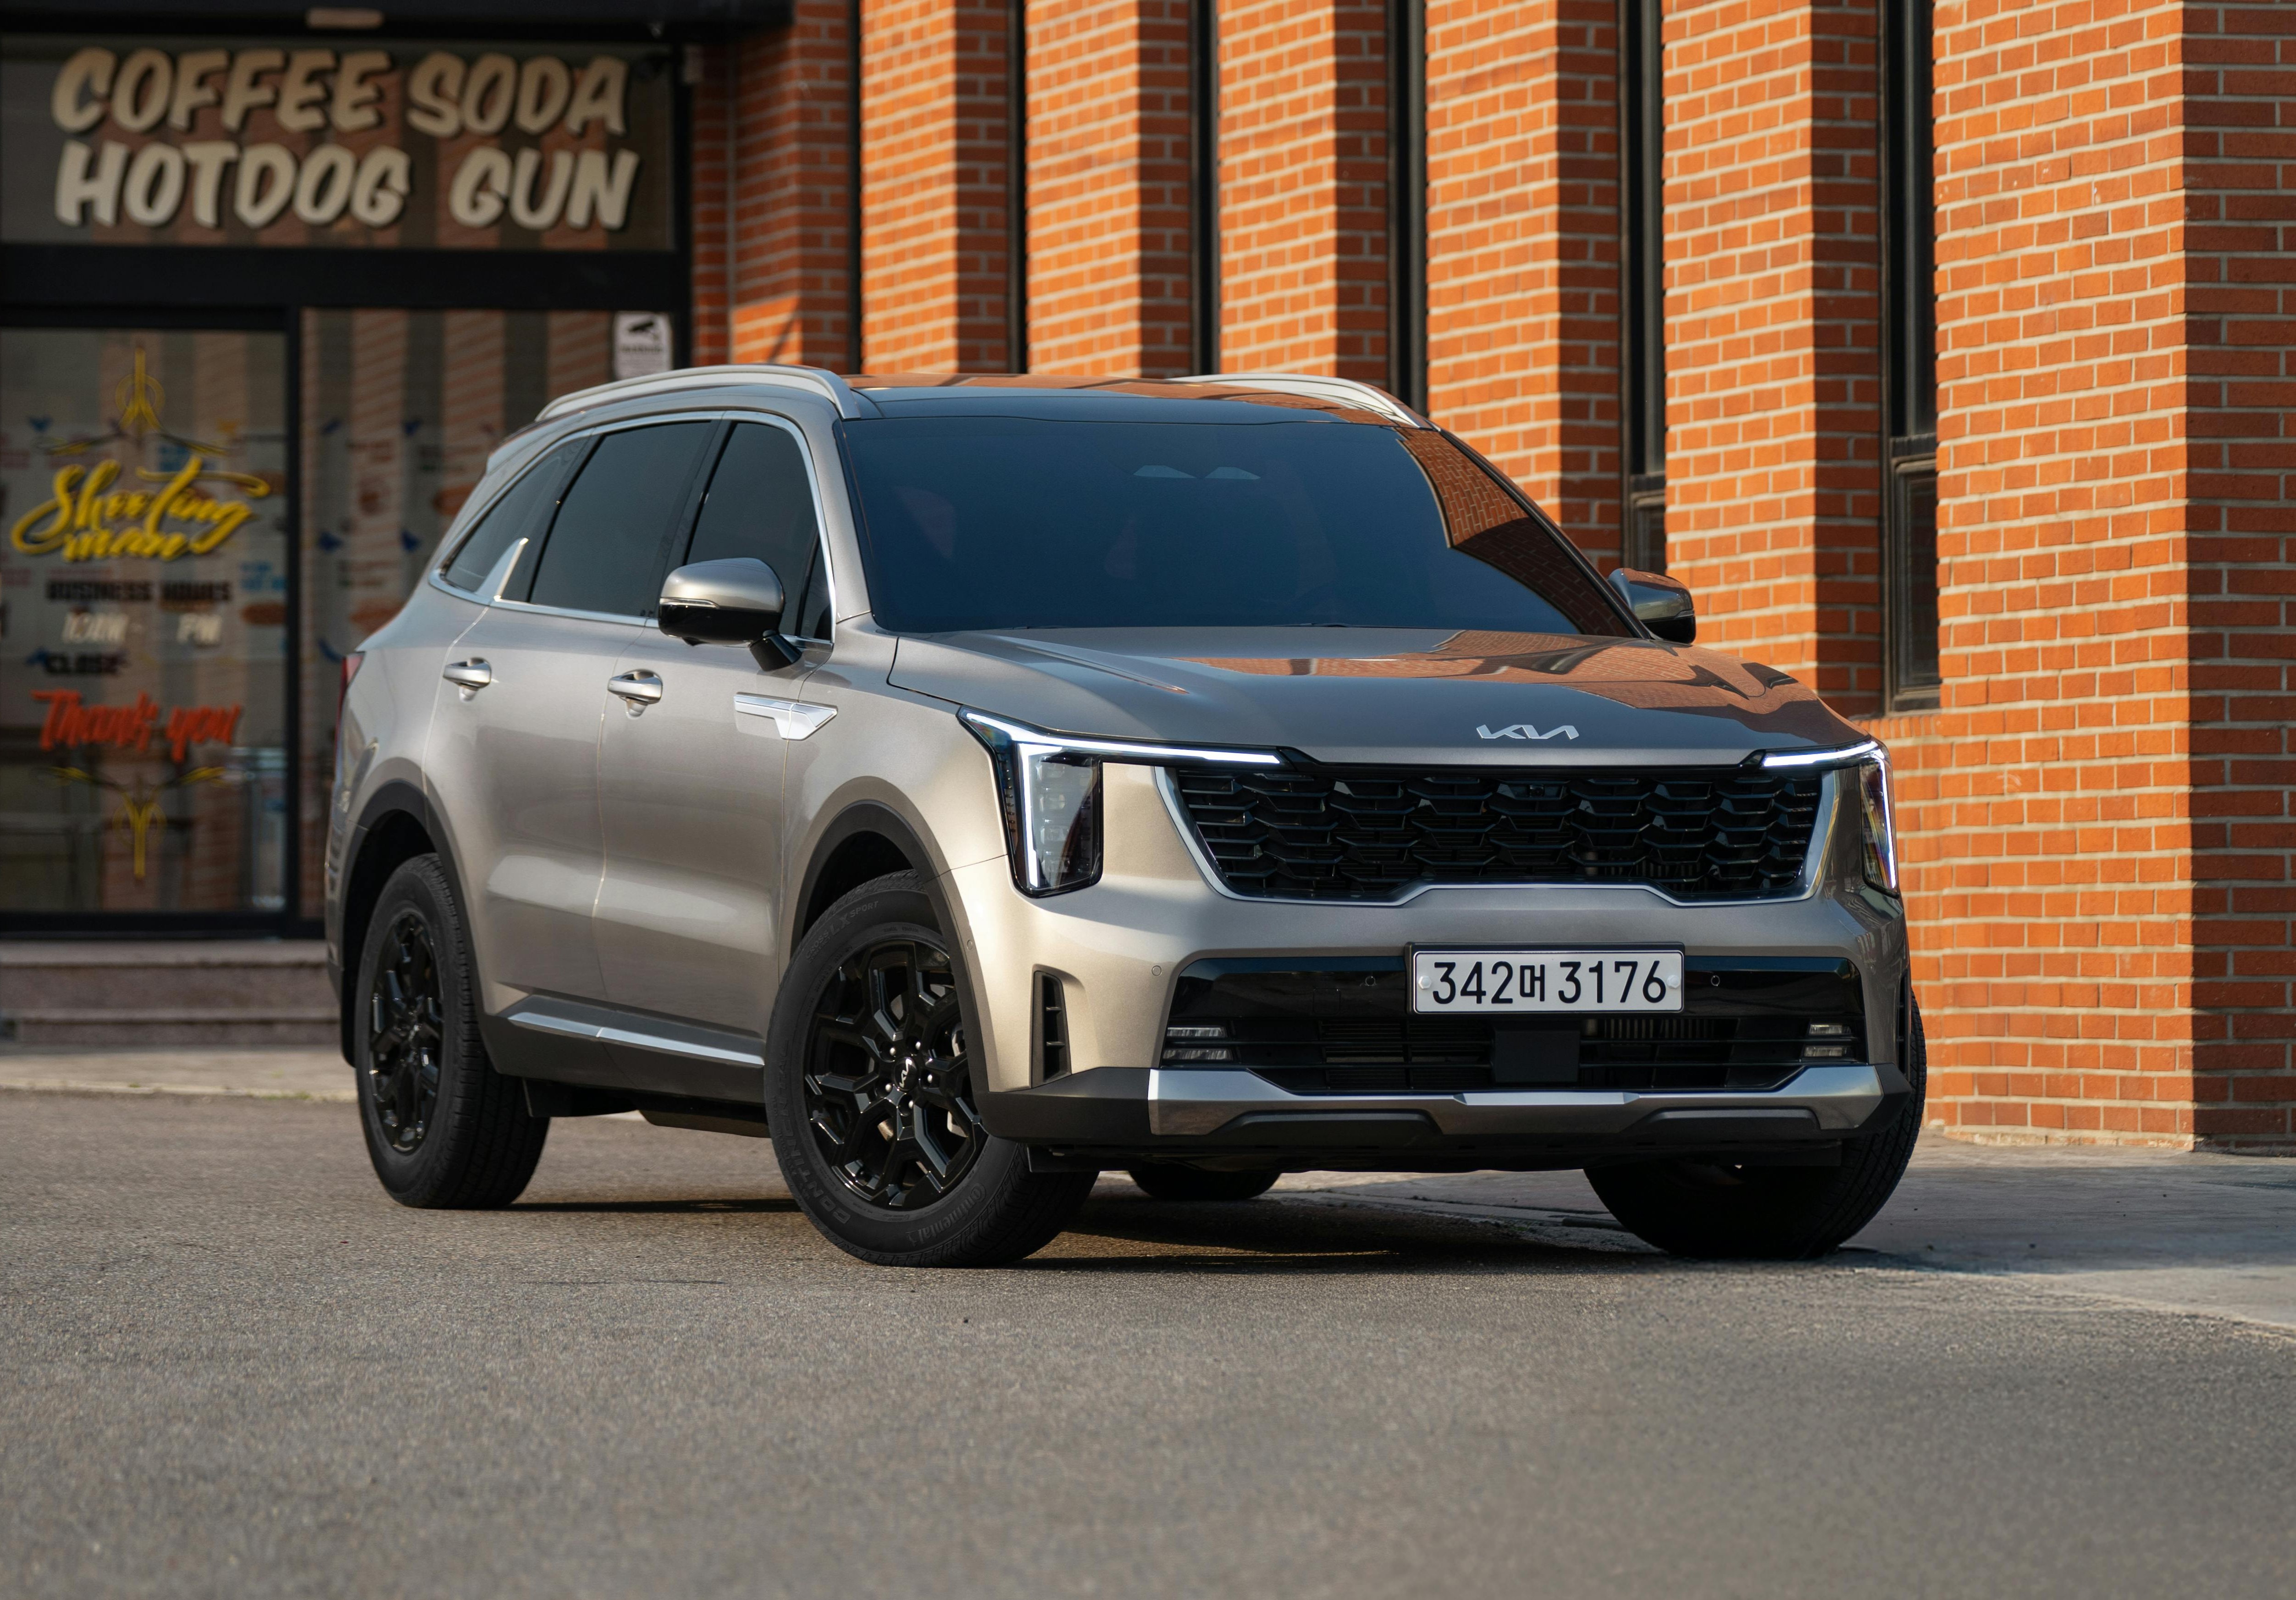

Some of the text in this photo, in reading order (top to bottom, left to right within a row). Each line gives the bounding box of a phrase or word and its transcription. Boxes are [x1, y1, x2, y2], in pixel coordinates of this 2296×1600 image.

[53, 48, 628, 137] COFFEE SODA
[54, 140, 639, 230] HOTDOG GUN
[30, 688, 243, 763] Thank you
[1476, 724, 1580, 740] KIA
[805, 900, 879, 959] CROSS LX SPORT
[1432, 960, 1667, 1004] 342머 3176
[917, 1182, 987, 1244] Continental
